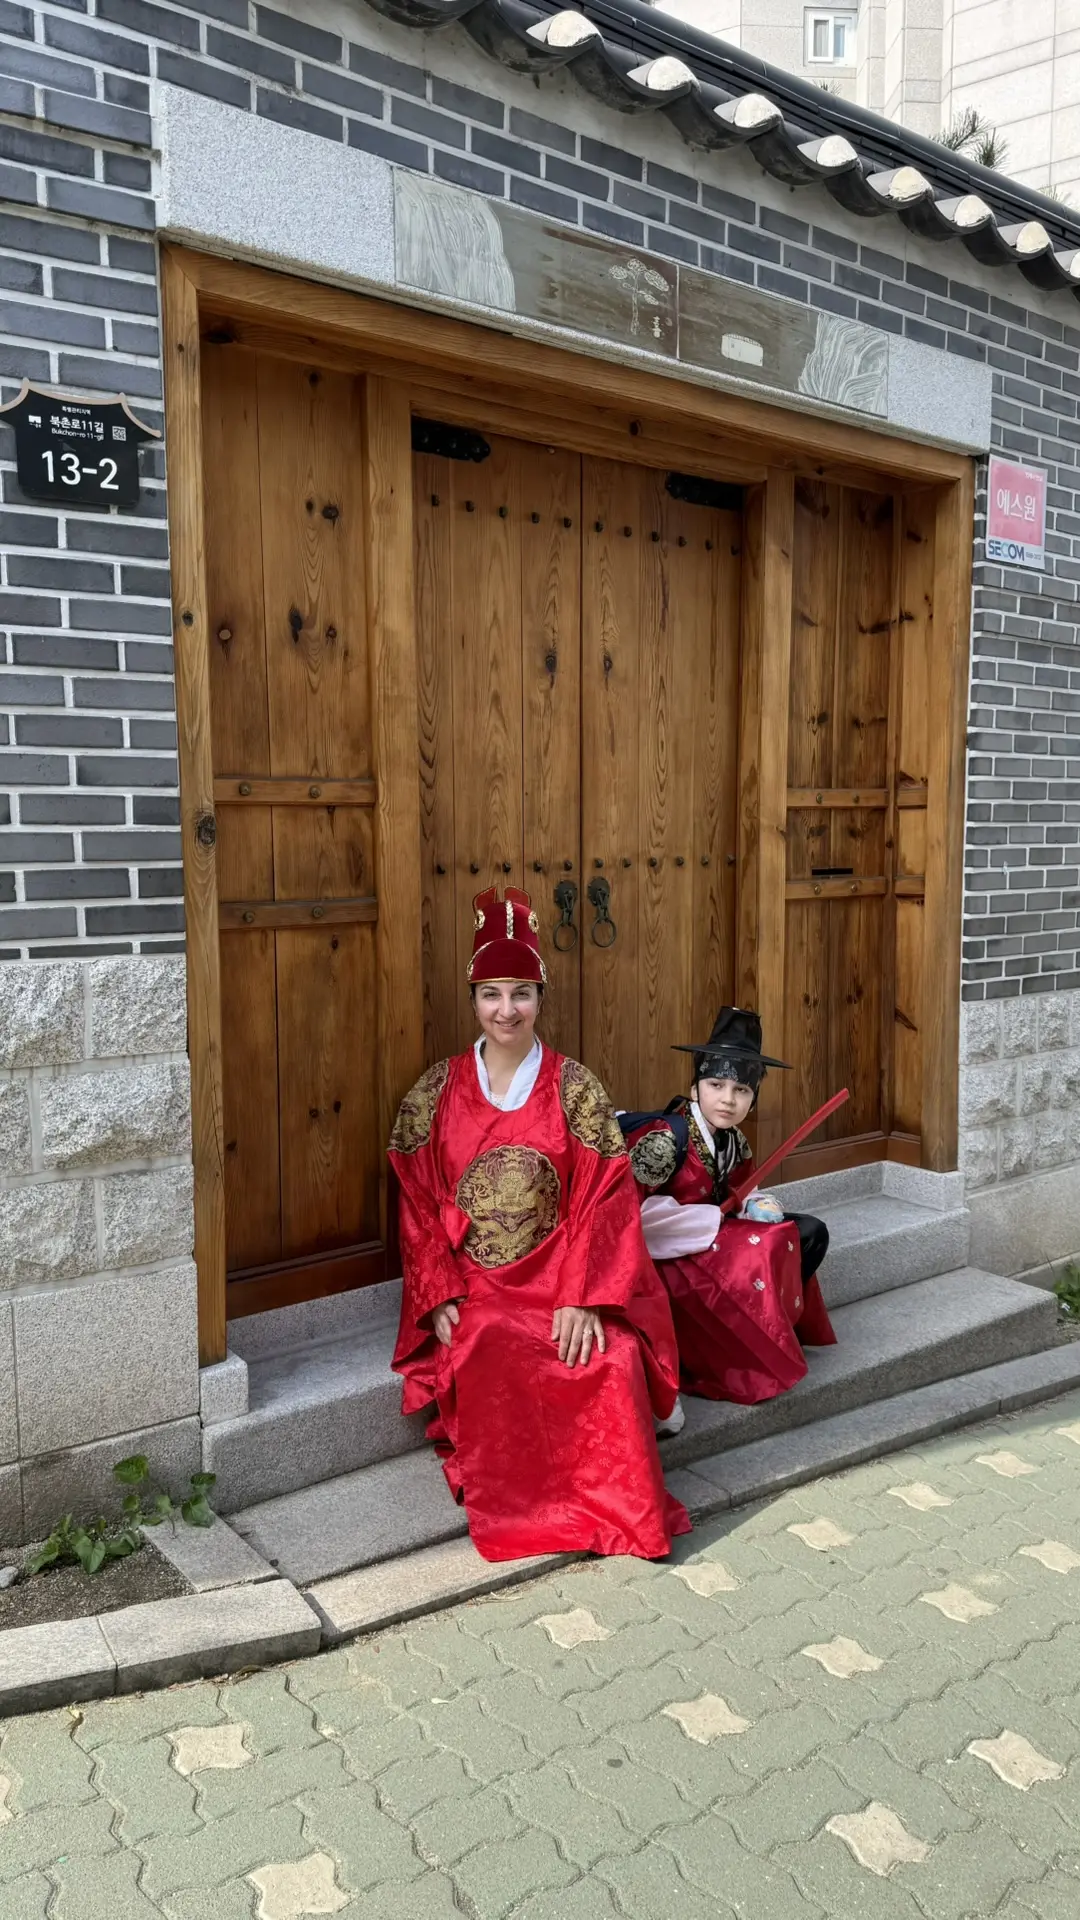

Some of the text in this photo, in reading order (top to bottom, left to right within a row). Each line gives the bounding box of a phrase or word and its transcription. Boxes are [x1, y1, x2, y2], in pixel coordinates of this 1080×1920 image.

[50, 415, 104, 433] 북촌로11길
[51, 428, 104, 442] Bukchon-ro 11-gil
[41, 450, 120, 491] 13-2
[997, 488, 1036, 522] 에스원
[988, 539, 1025, 562] SECOM
